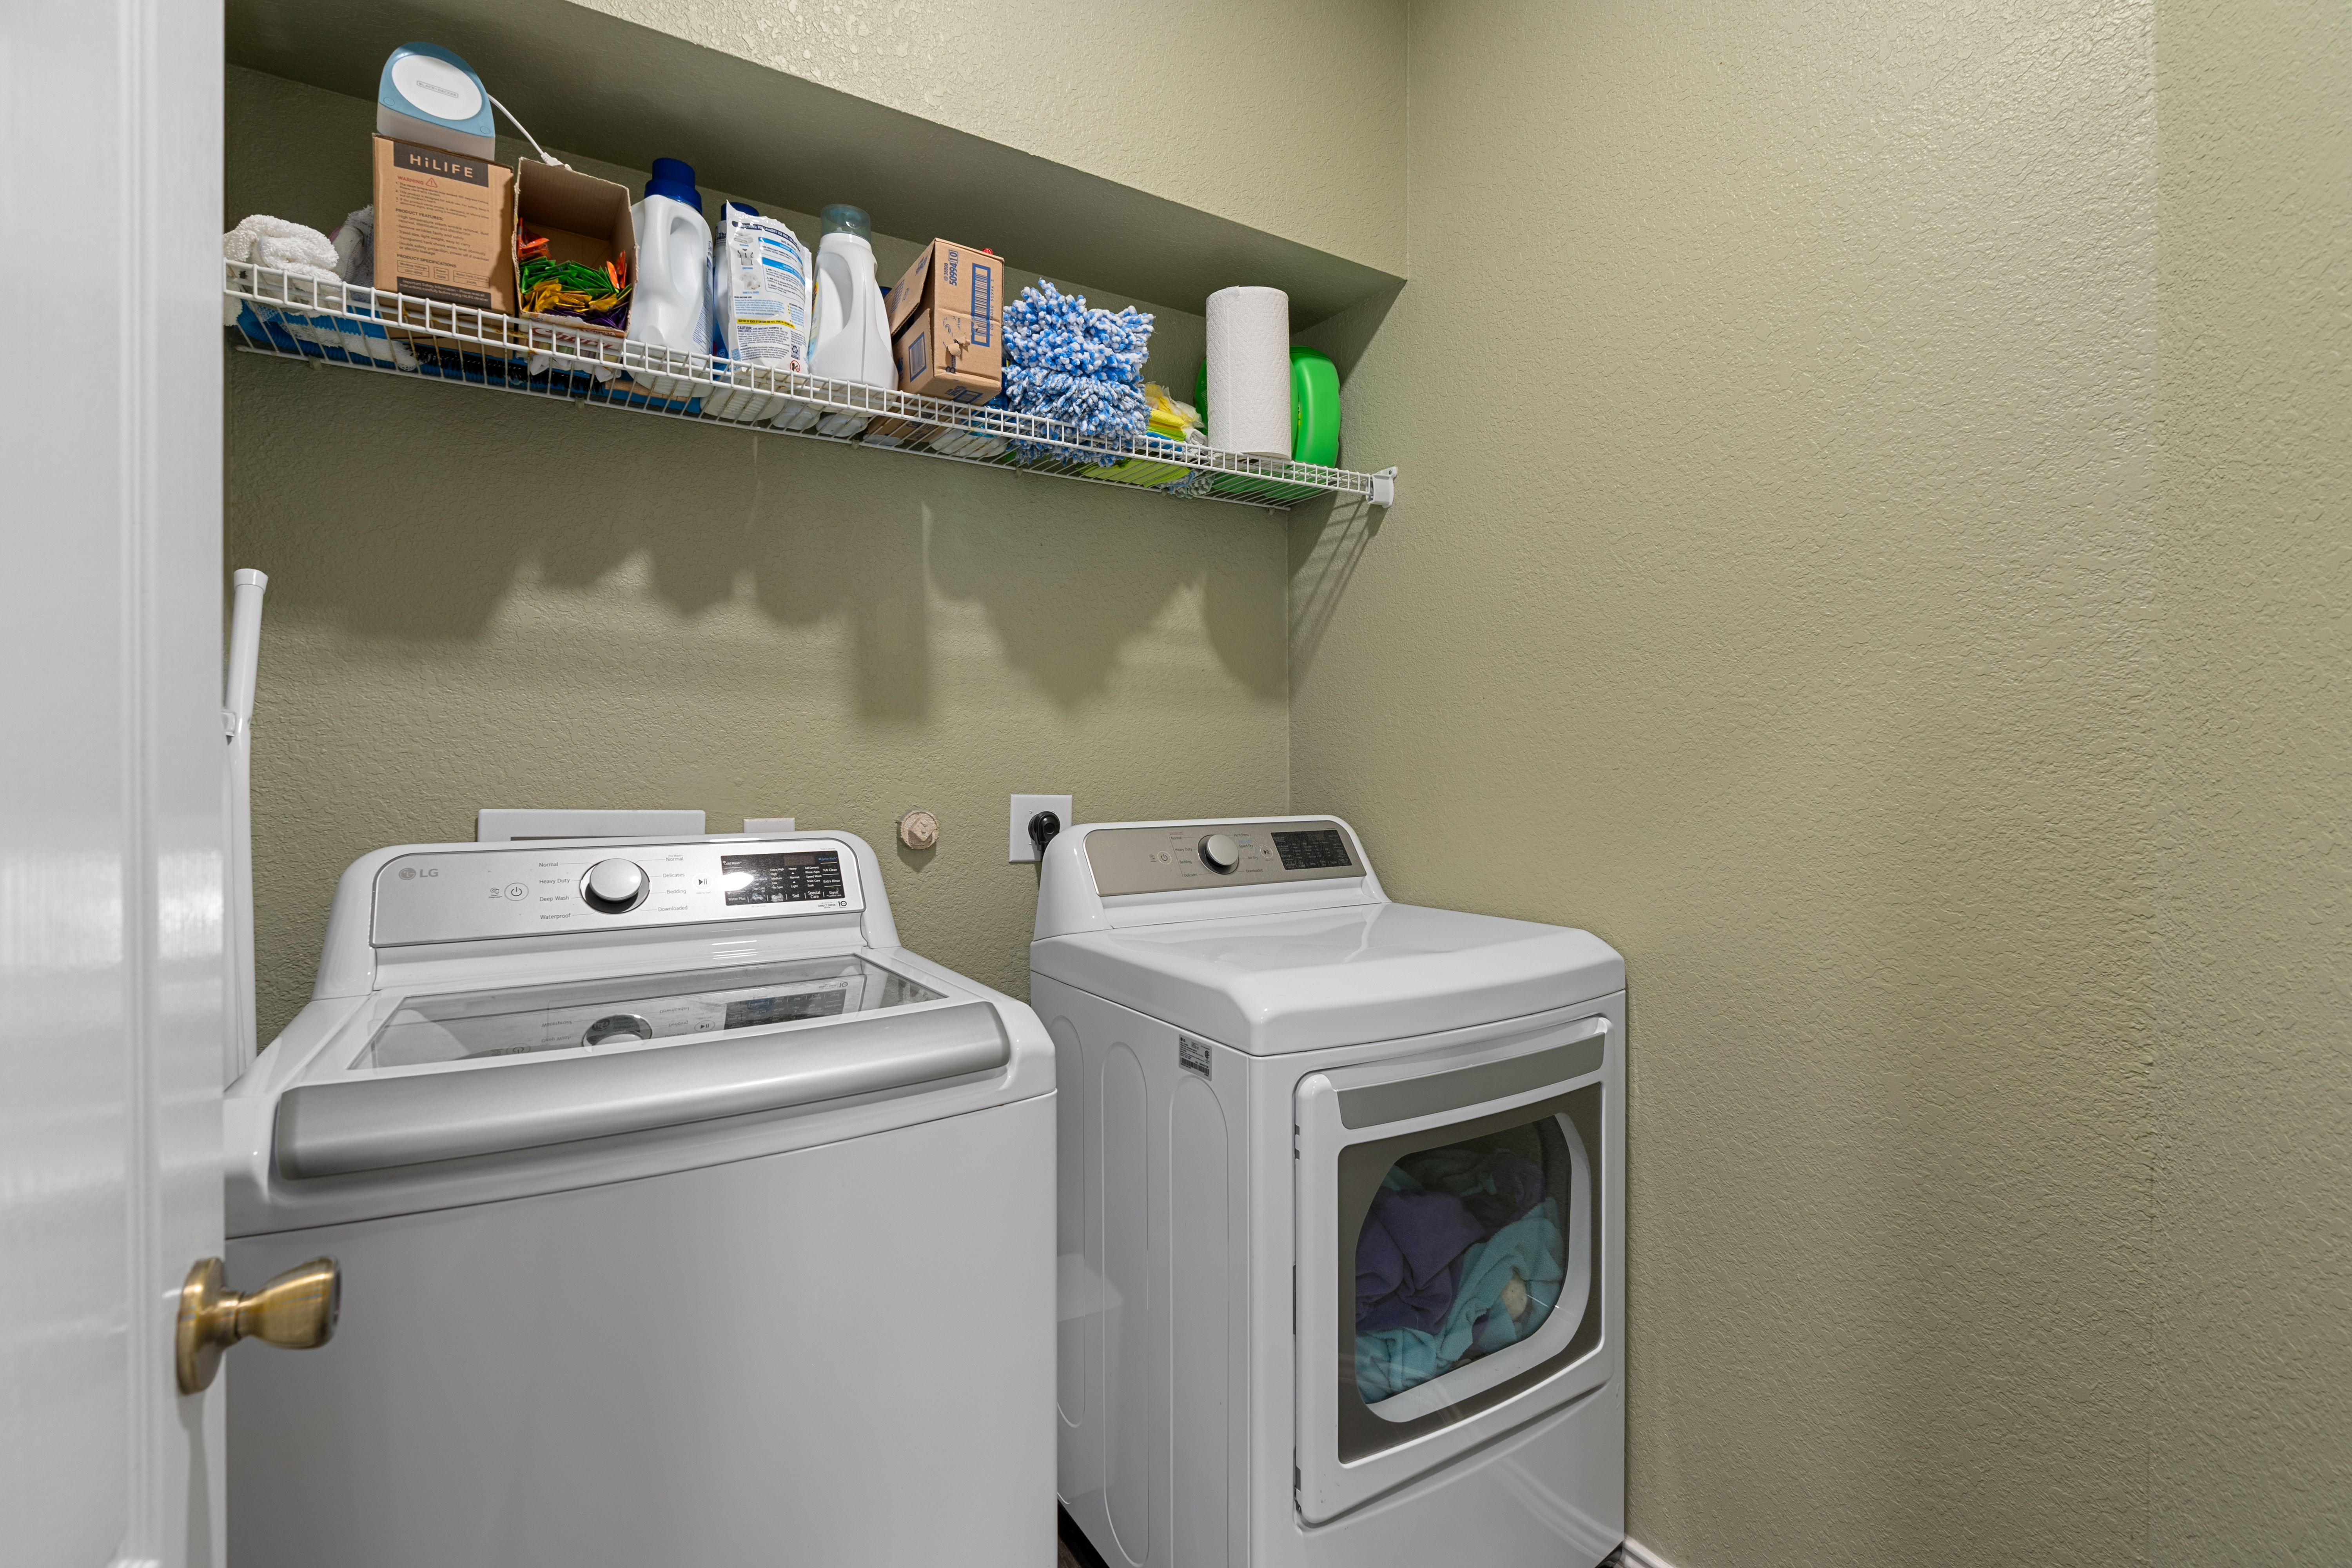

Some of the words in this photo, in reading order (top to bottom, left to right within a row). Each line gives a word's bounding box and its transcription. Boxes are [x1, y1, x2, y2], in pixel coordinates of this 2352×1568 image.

[418, 82, 457, 96] BLACK+DECKER
[410, 154, 473, 178] HiLIFE
[397, 175, 424, 185] WARNING
[396, 207, 417, 216] PRODUCT
[397, 253, 419, 261] PRODUCT
[420, 258, 456, 269] SPECIFICATIONS
[420, 869, 438, 877] LG
